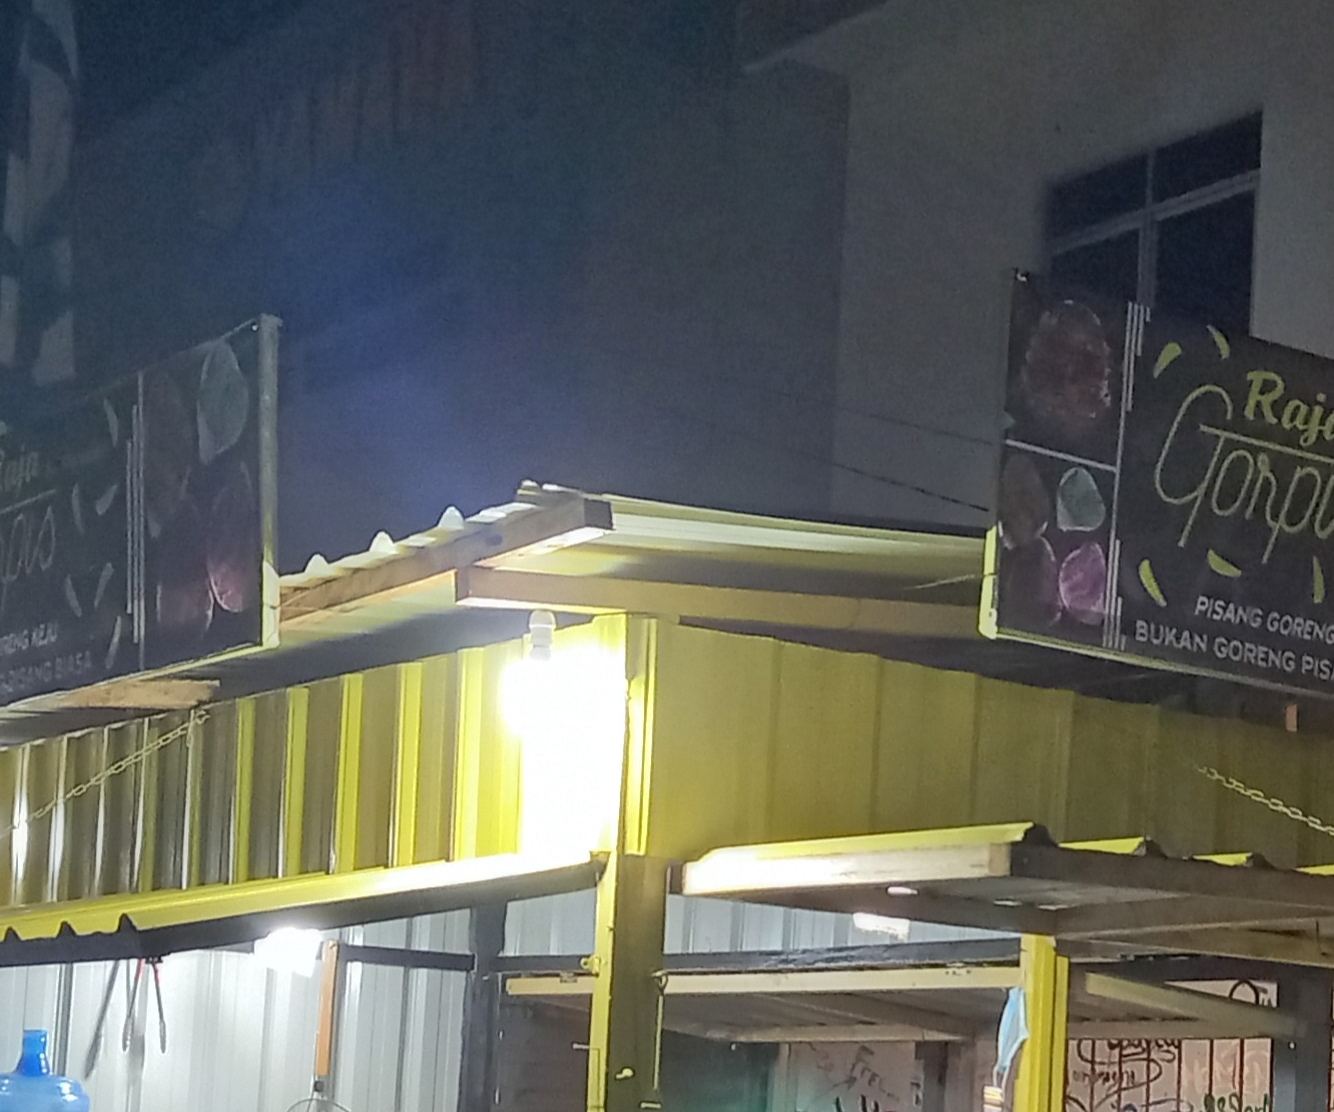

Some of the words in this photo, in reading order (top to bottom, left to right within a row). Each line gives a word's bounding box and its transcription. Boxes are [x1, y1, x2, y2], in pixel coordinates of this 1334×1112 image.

[1194, 595, 1263, 628] PISANG
[1134, 619, 1208, 653] BUKAN
[1212, 636, 1296, 673] GORENG
